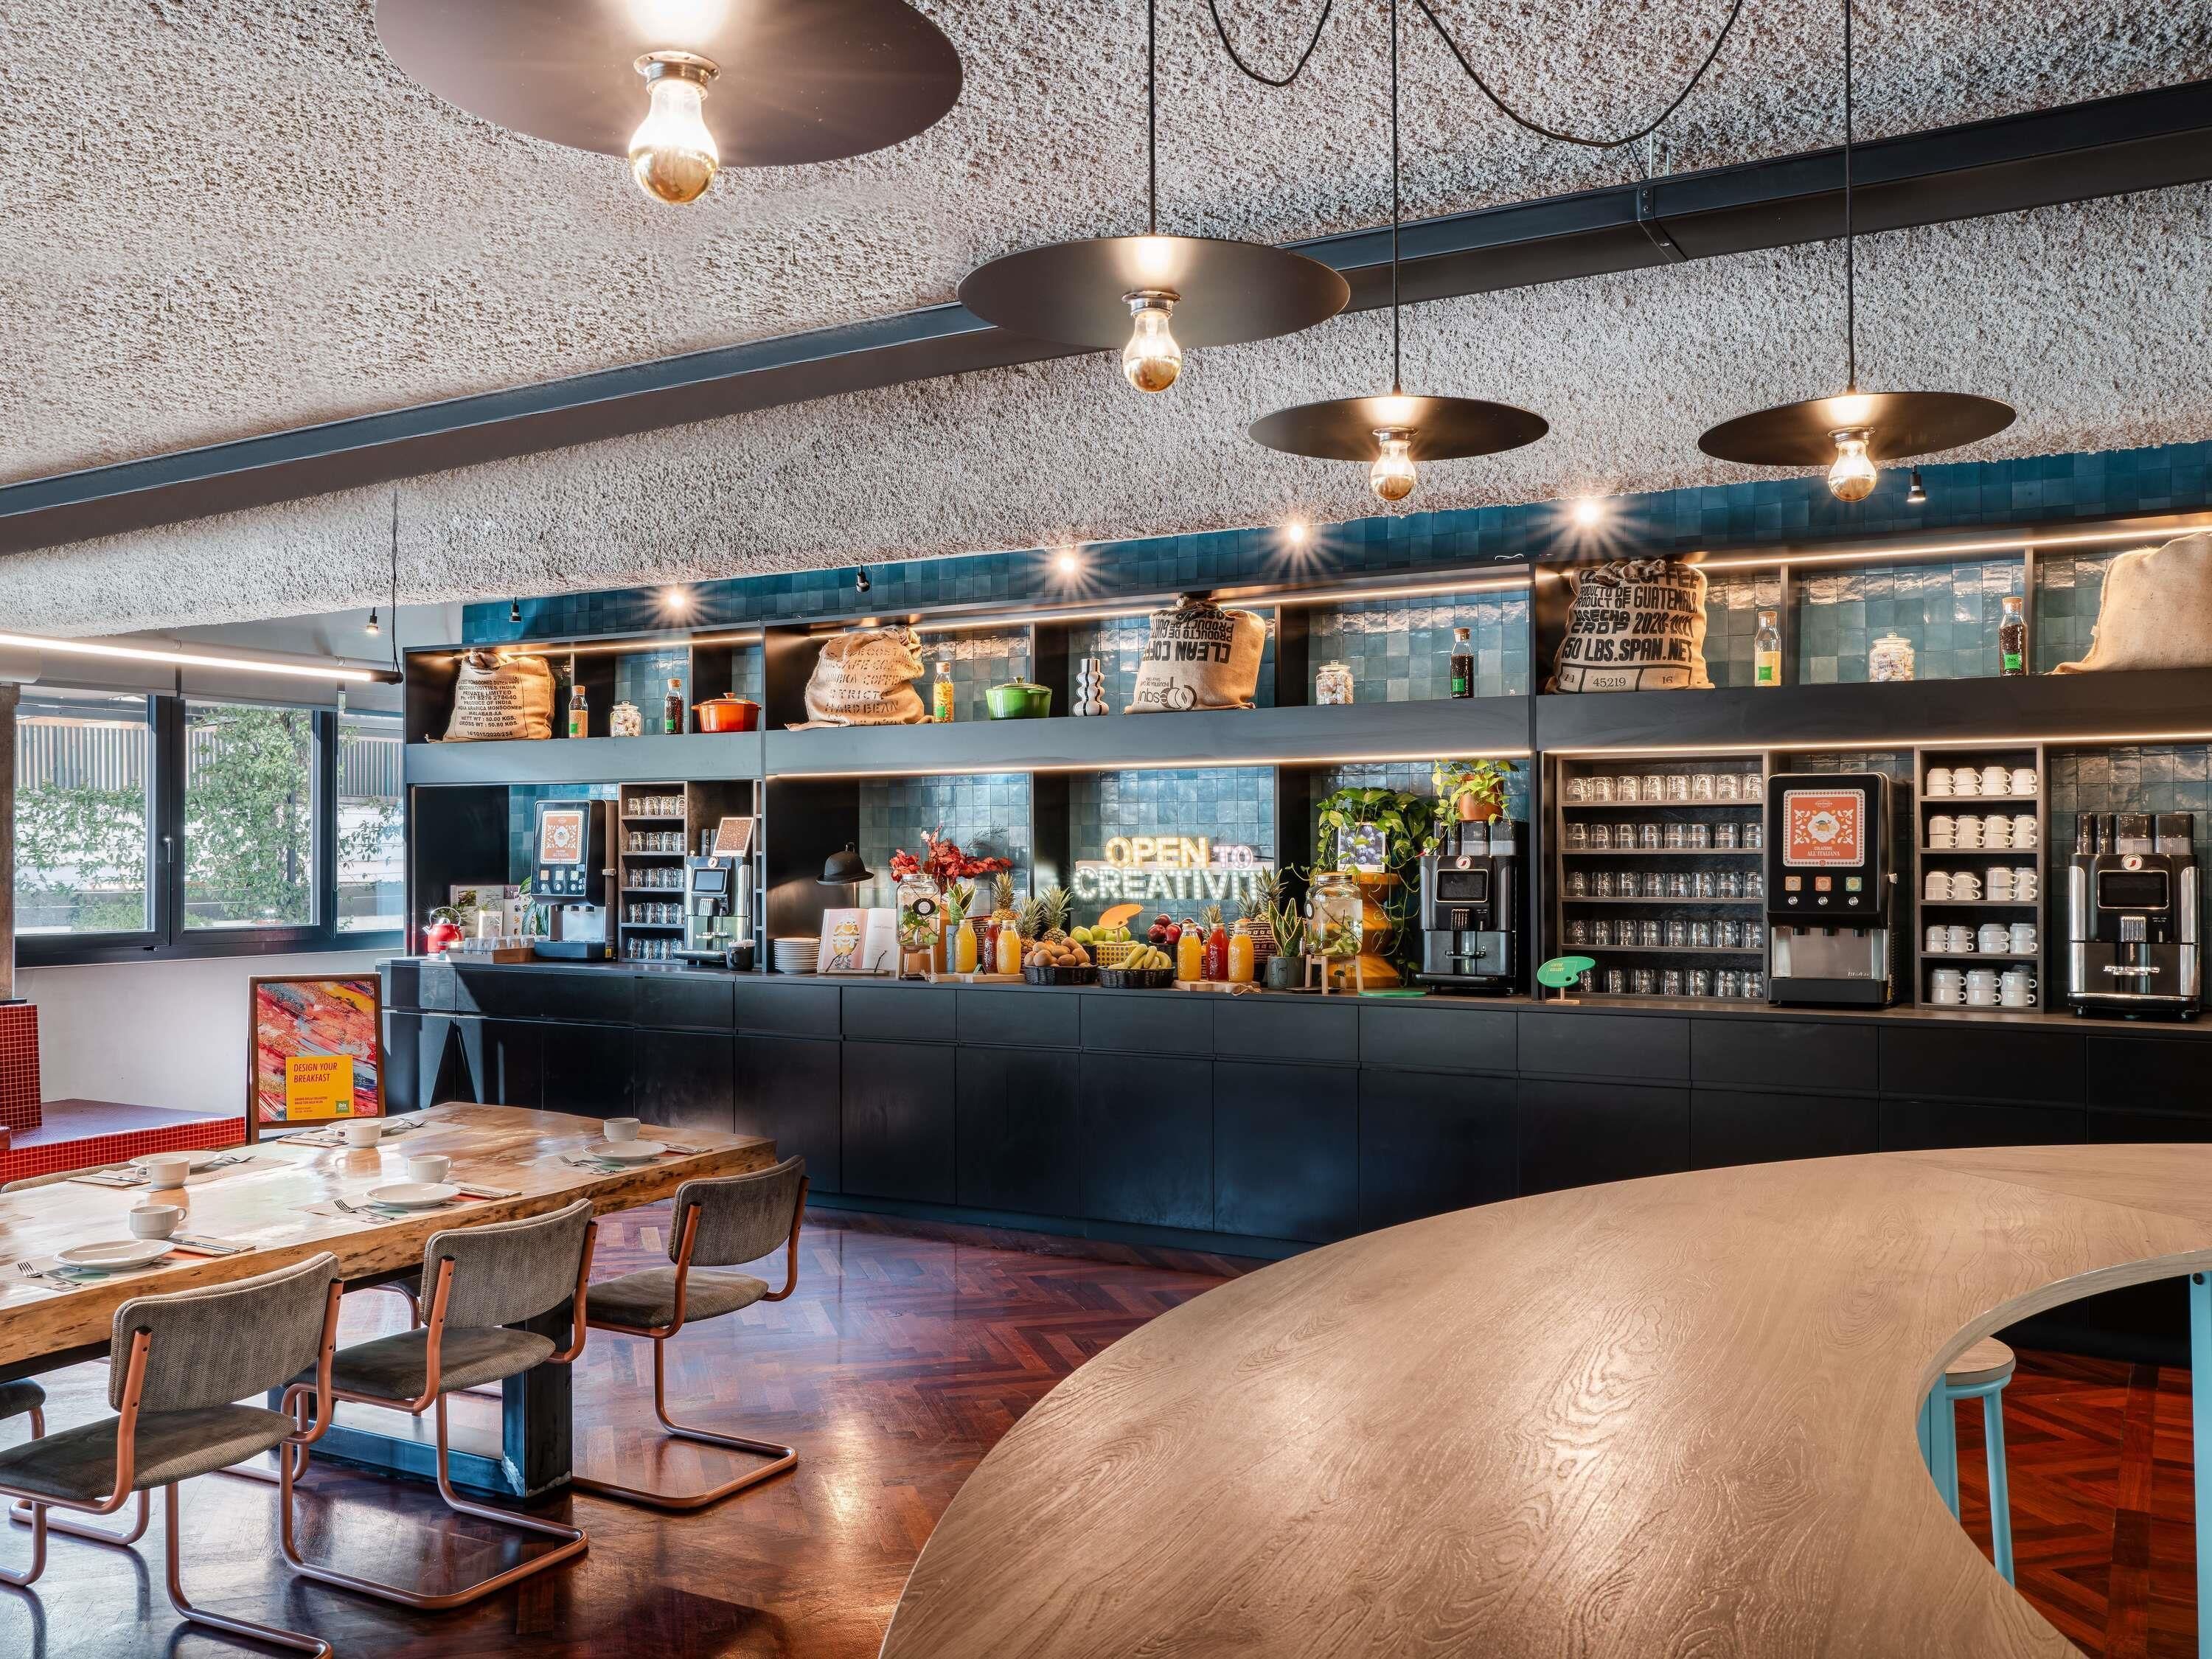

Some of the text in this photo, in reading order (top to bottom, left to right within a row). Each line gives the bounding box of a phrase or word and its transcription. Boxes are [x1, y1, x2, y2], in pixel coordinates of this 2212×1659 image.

[1579, 586, 1631, 598] PRODUCTO DE
[1573, 597, 1630, 608] PRODUCT OF
[1634, 586, 1697, 613] GUATEMALA
[1183, 619, 1234, 633] PRODUCT
[1571, 622, 1630, 634] CROP
[1169, 629, 1232, 642] PRODUCTO DE
[1175, 641, 1231, 664] CLEAN
[1593, 678, 1626, 686] 45219
[1662, 676, 1674, 684] 16
[864, 700, 898, 714] BEAN
[1105, 837, 1253, 869] OPEN TO
[1073, 867, 1272, 900] CREATIVIT
[293, 1062, 338, 1072] DESIGN YOUR
[293, 1074, 330, 1083] BREAKFAST
